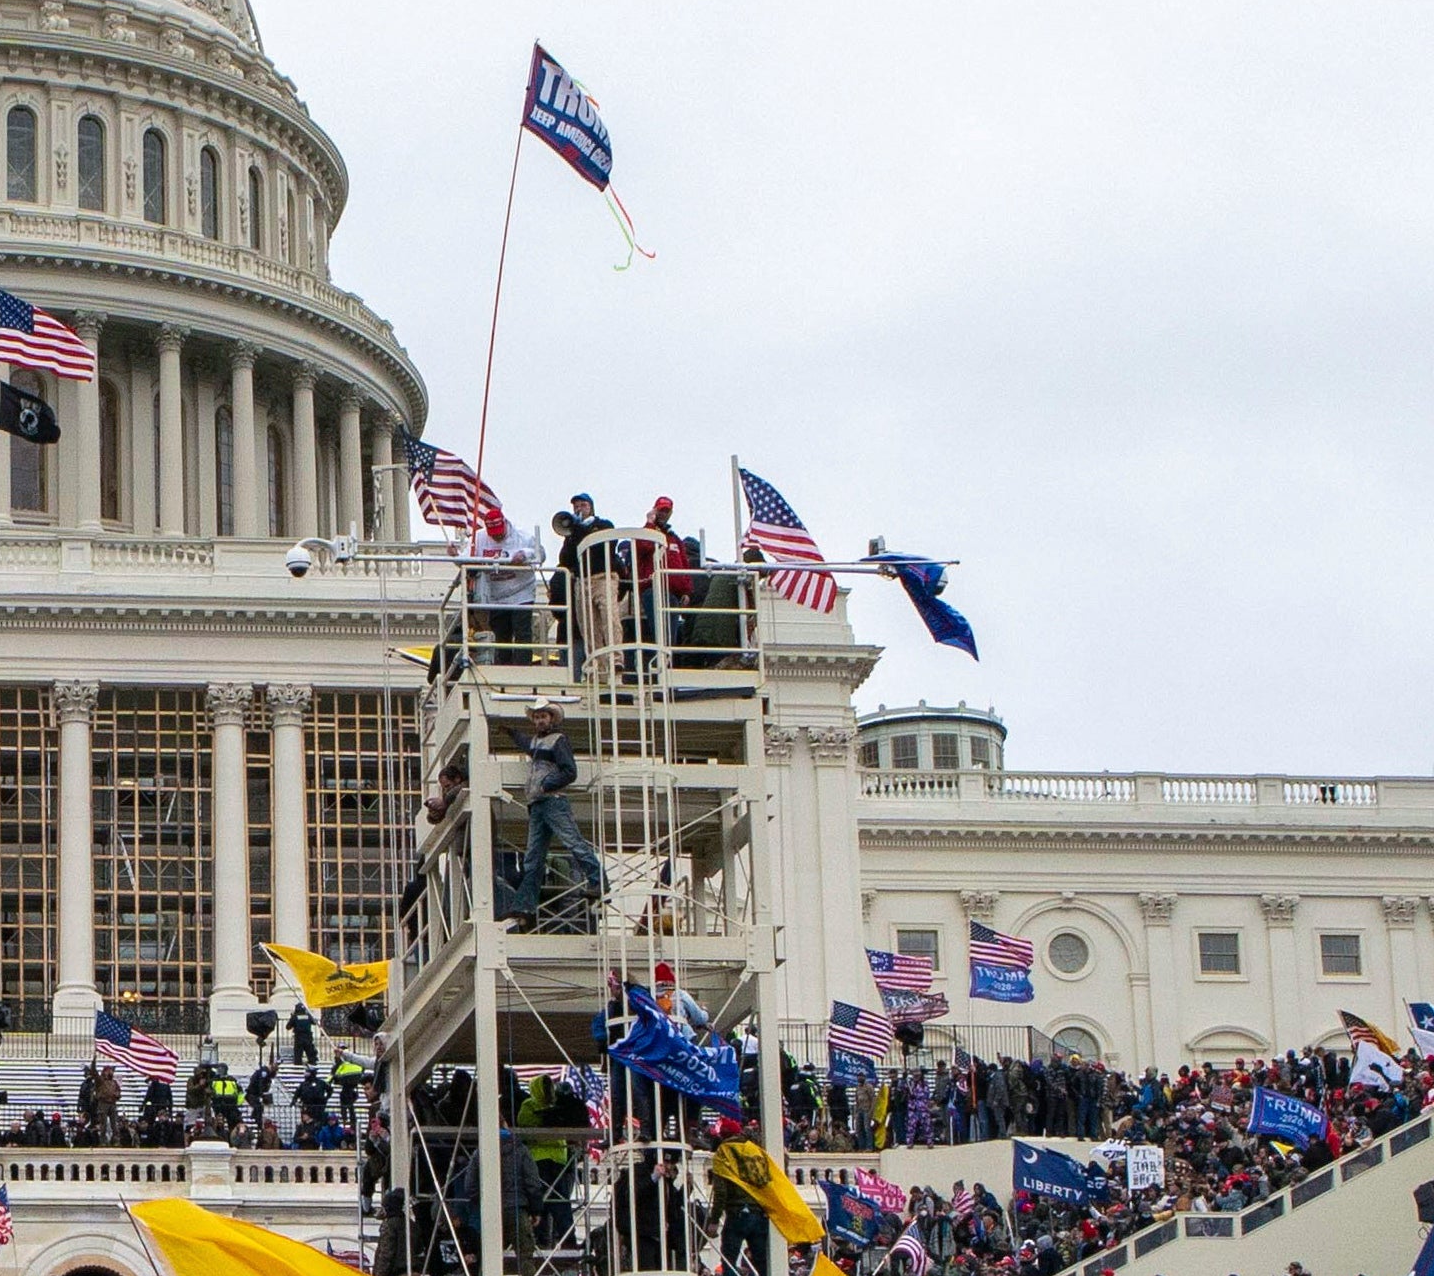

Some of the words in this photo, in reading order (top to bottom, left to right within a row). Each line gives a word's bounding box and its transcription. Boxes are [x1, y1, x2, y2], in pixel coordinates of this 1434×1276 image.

[530, 104, 557, 128] KEEP
[1263, 1095, 1322, 1124] TRUMP
[1022, 1176, 1082, 1201] LIBERTY
